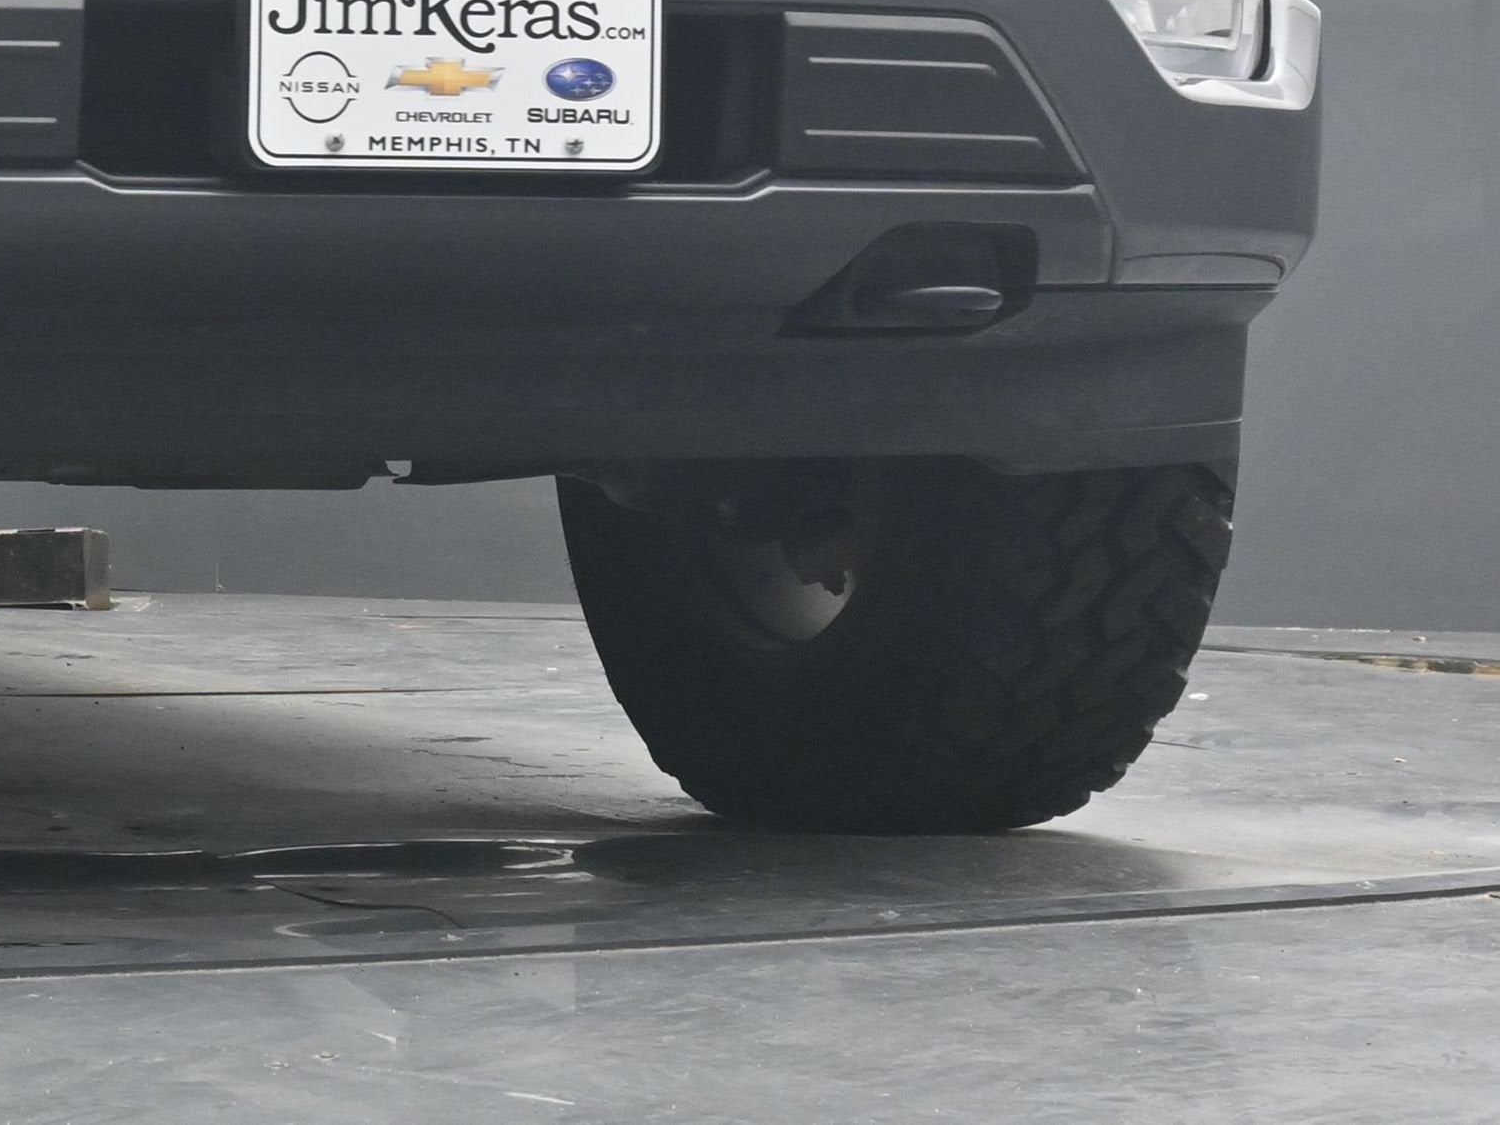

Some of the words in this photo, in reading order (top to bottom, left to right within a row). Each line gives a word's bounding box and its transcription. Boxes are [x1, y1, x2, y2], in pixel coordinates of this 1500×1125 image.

[278, 80, 361, 95] NISSAN
[395, 110, 493, 124] CHEVROLET
[526, 107, 629, 125] SUBARU
[368, 135, 496, 155] MEMPHIS,
[504, 137, 542, 154] TN
